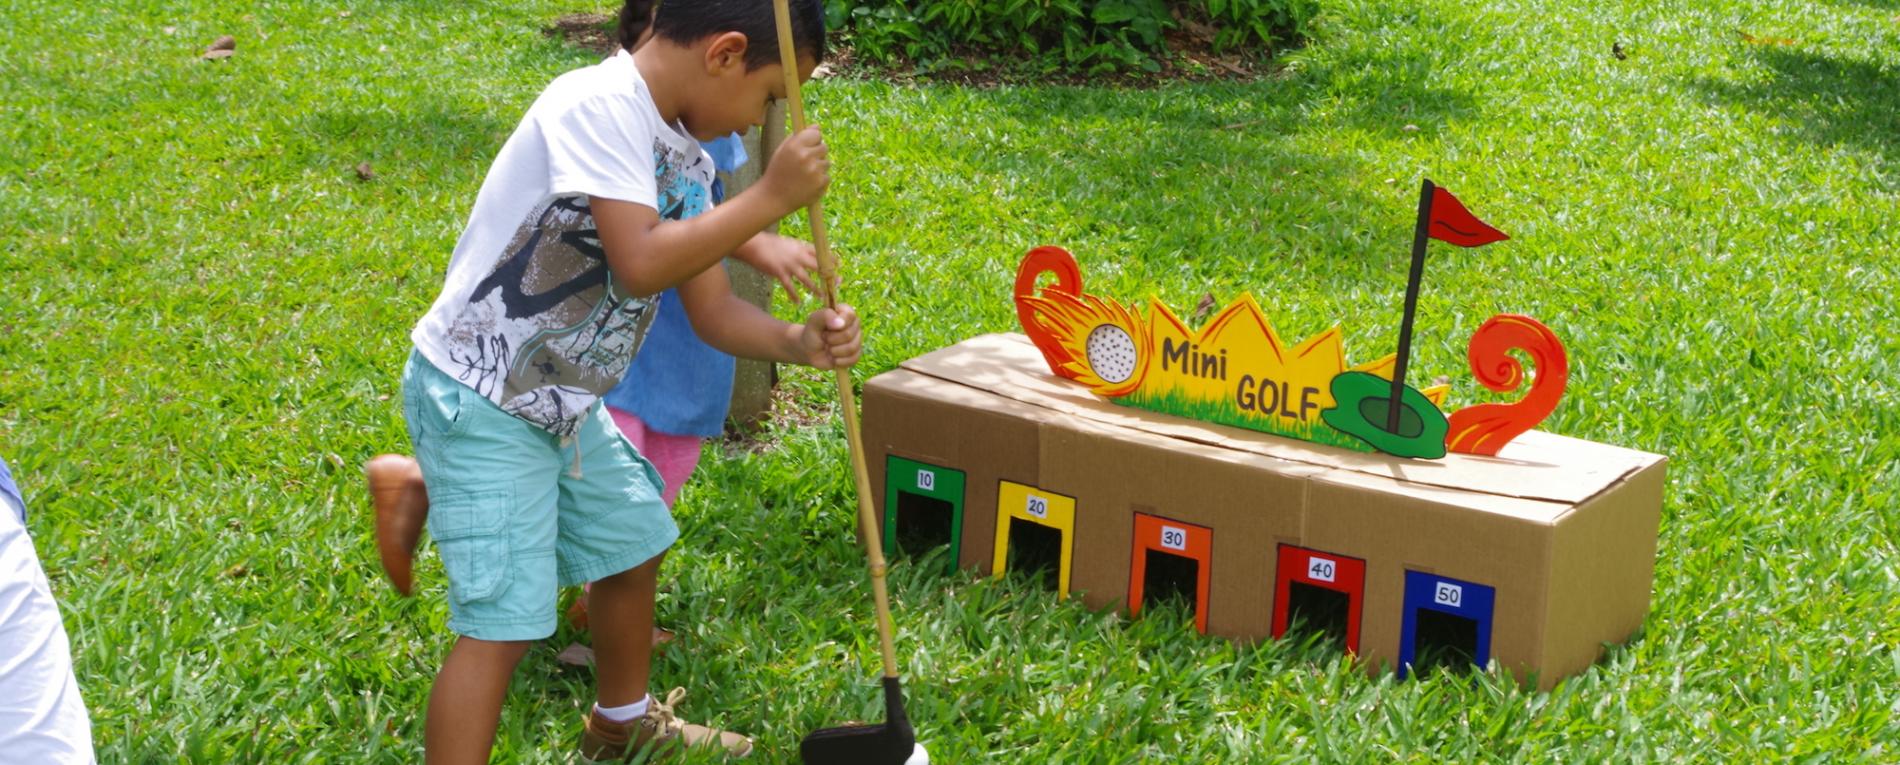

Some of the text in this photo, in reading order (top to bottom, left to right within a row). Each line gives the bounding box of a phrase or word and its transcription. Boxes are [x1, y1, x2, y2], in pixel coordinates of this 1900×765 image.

[1162, 336, 1320, 421] Mini GOLF
[919, 472, 932, 487] 10
[1028, 499, 1045, 514] 20
[1163, 530, 1183, 546] 30
[1310, 562, 1333, 578] 40
[1437, 587, 1459, 603] 50
